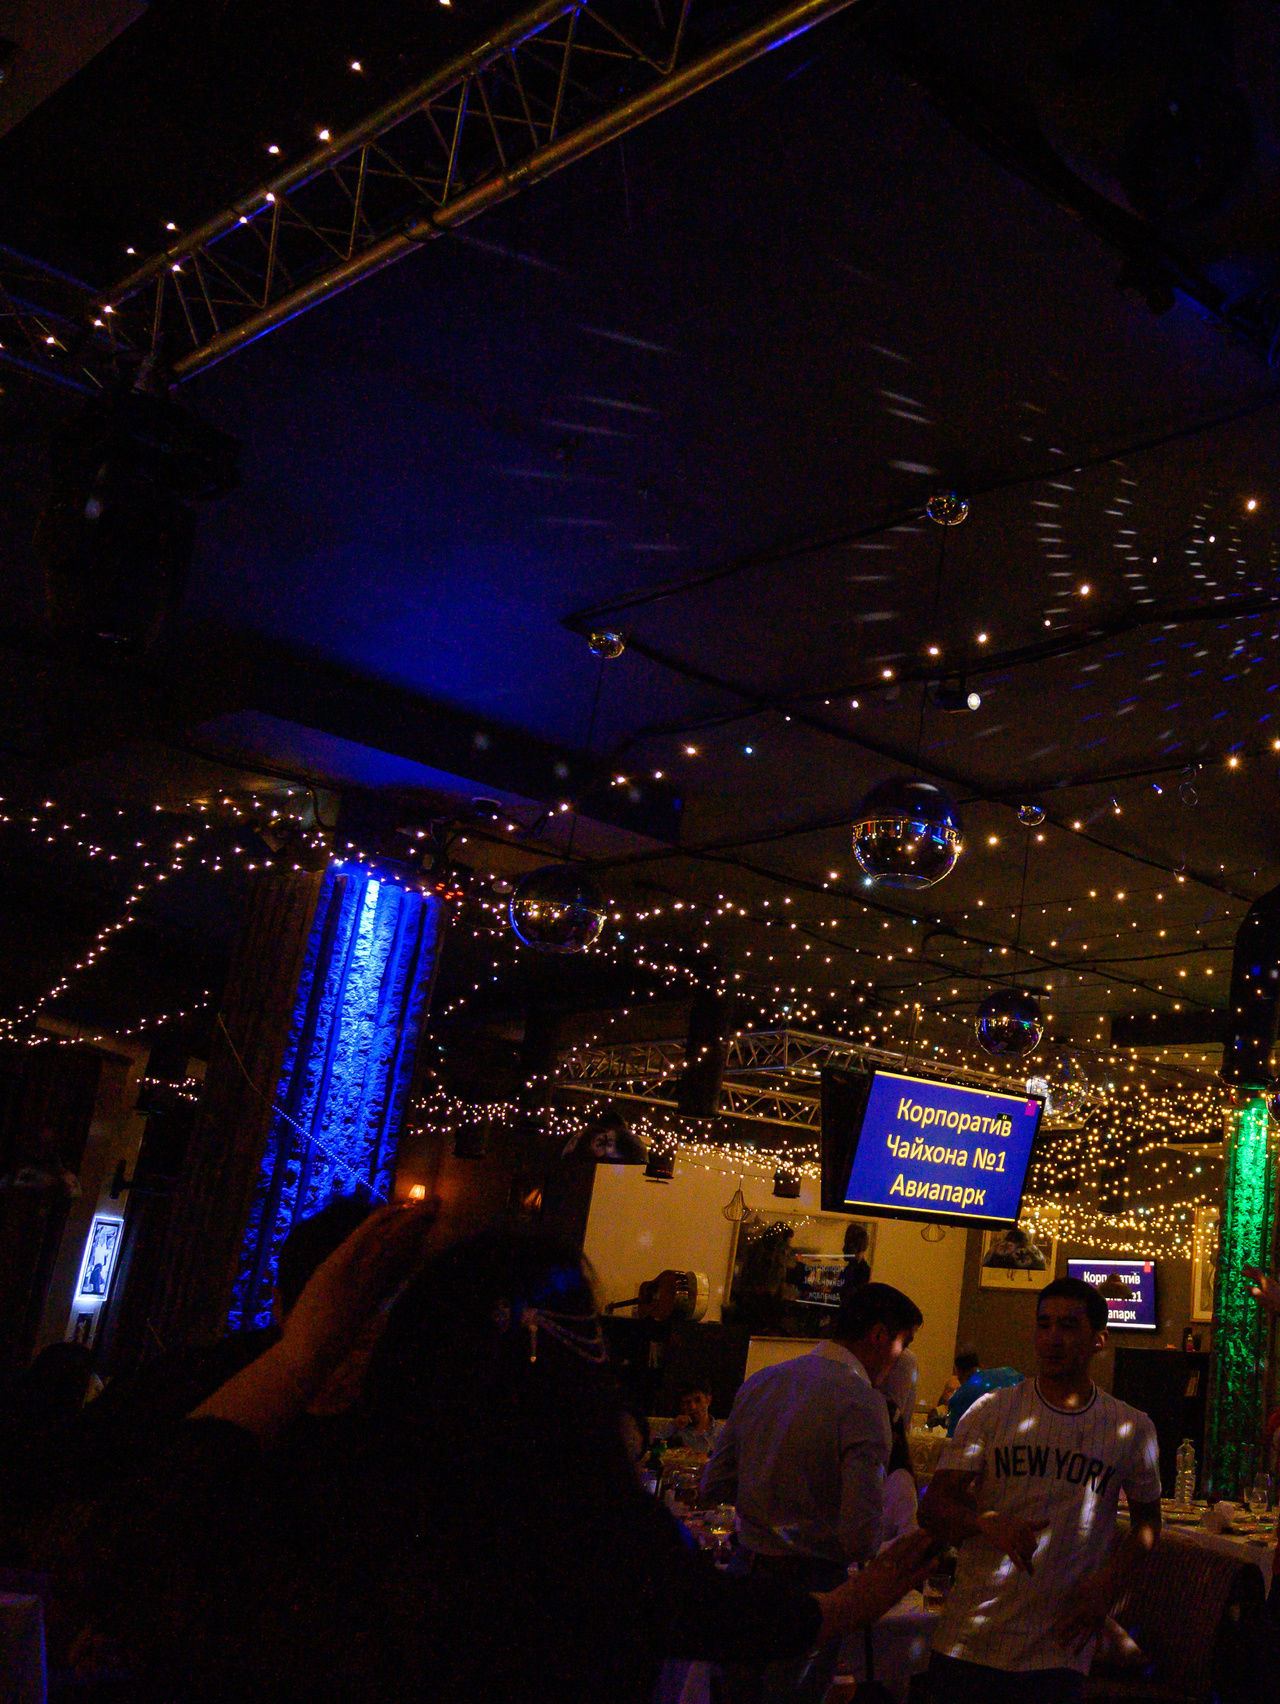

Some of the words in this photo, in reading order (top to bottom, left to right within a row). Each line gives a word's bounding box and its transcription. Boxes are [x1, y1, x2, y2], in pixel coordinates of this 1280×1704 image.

[897, 1097, 1012, 1137] Корпоратив
[886, 1134, 968, 1167] Чайхона
[972, 1147, 1006, 1172] №1
[889, 1173, 986, 1209] Авиапарк
[1083, 1271, 1141, 1286] Корпатив
[1107, 1309, 1136, 1322] апарк
[995, 1445, 1050, 1479] NEW
[1055, 1448, 1116, 1497] YORK
